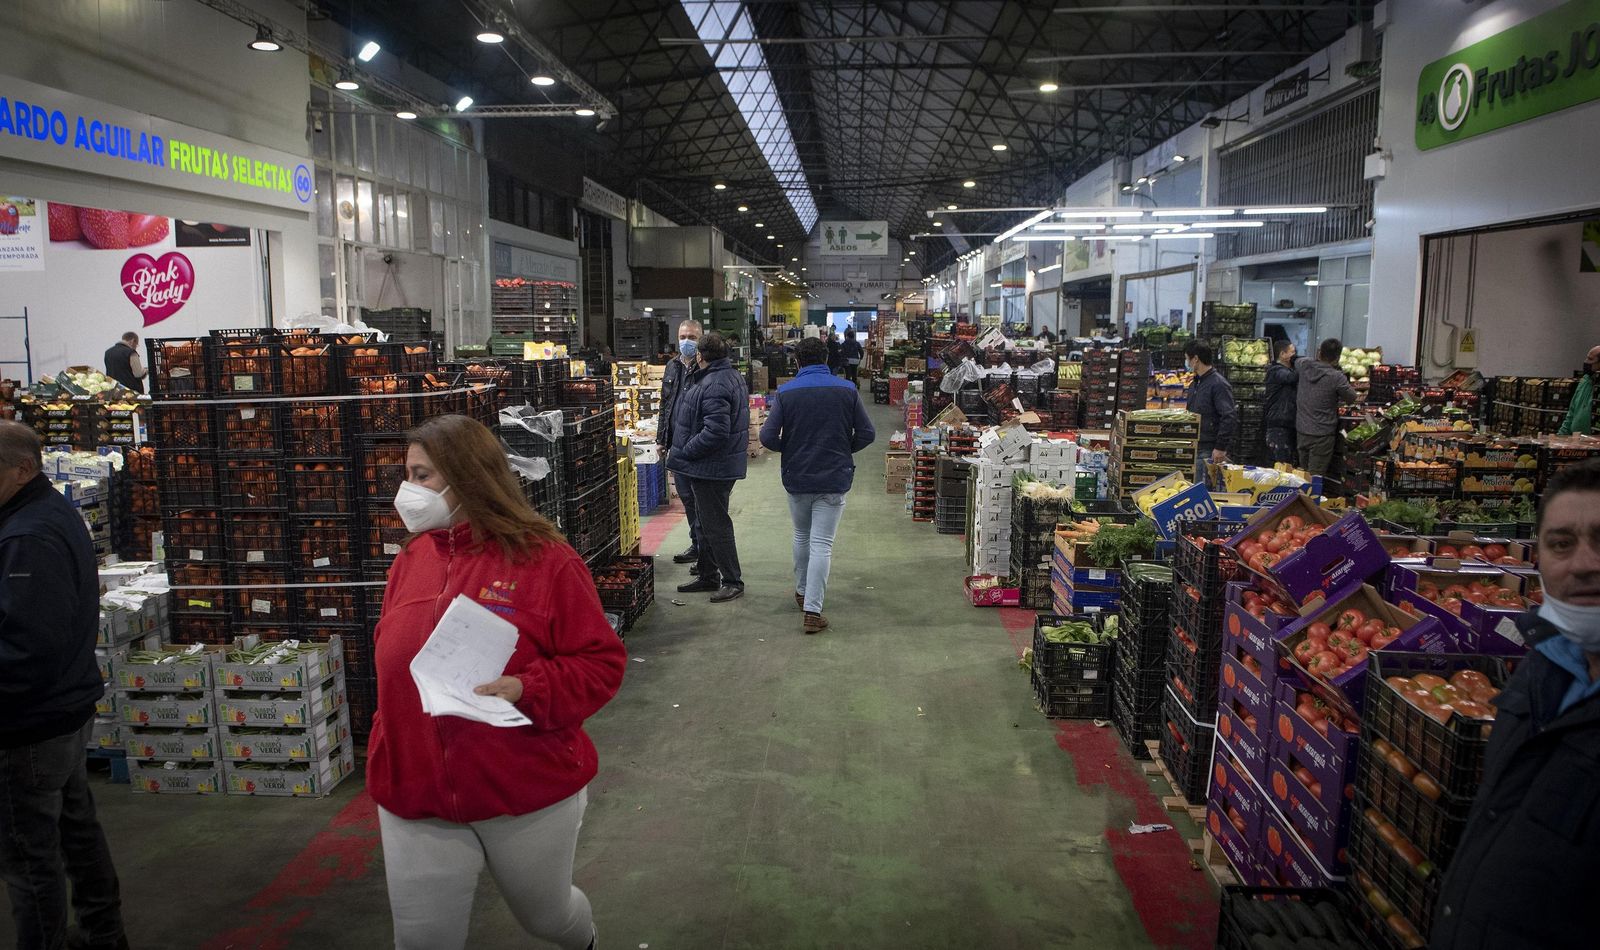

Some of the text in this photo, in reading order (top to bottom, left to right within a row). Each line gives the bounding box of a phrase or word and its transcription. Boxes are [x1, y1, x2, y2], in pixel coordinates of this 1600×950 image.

[1473, 51, 1558, 109] Frutas
[0, 96, 293, 193] ARDO AGUILAR FRUTAS SELECTAS
[131, 260, 179, 295] Pink
[139, 280, 186, 310] Lady
[254, 712, 276, 720] VERDE
